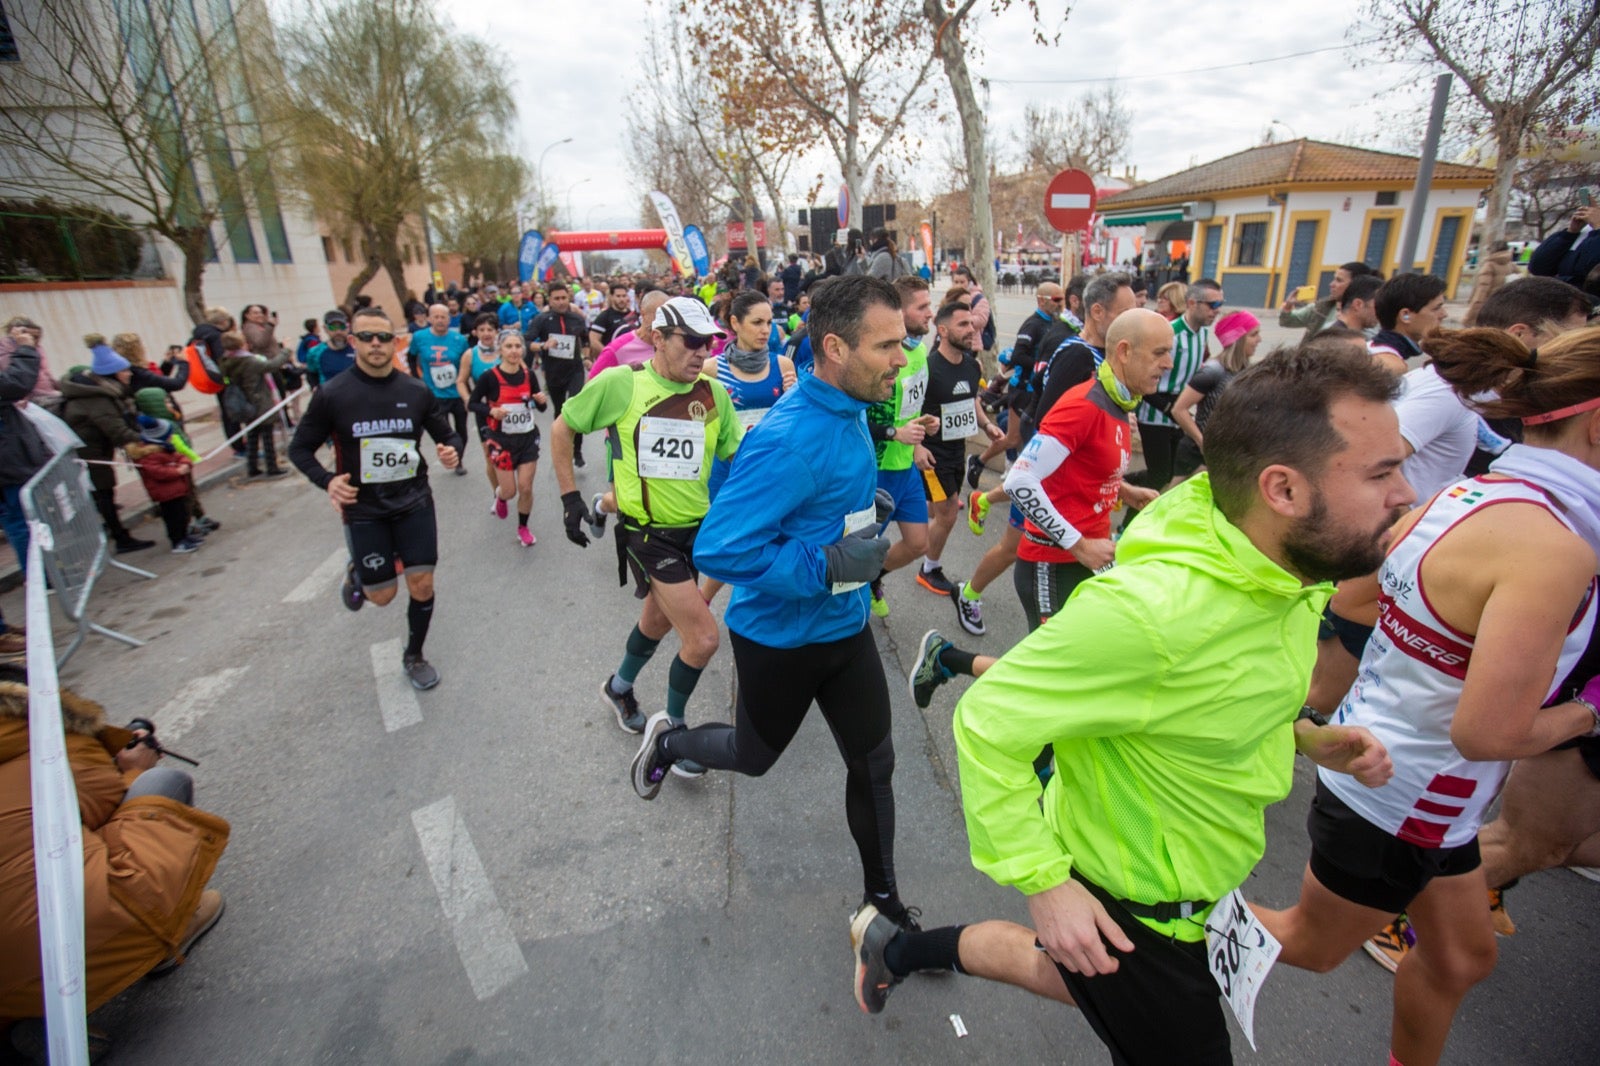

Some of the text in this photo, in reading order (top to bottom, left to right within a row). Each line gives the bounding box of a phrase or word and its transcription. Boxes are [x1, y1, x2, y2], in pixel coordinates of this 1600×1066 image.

[908, 381, 924, 403] 781
[352, 418, 413, 435] GRANADA
[945, 411, 975, 429] 3095
[651, 437, 694, 460] 420
[372, 452, 409, 467] 564
[1015, 487, 1066, 542] ÓRGIVA
